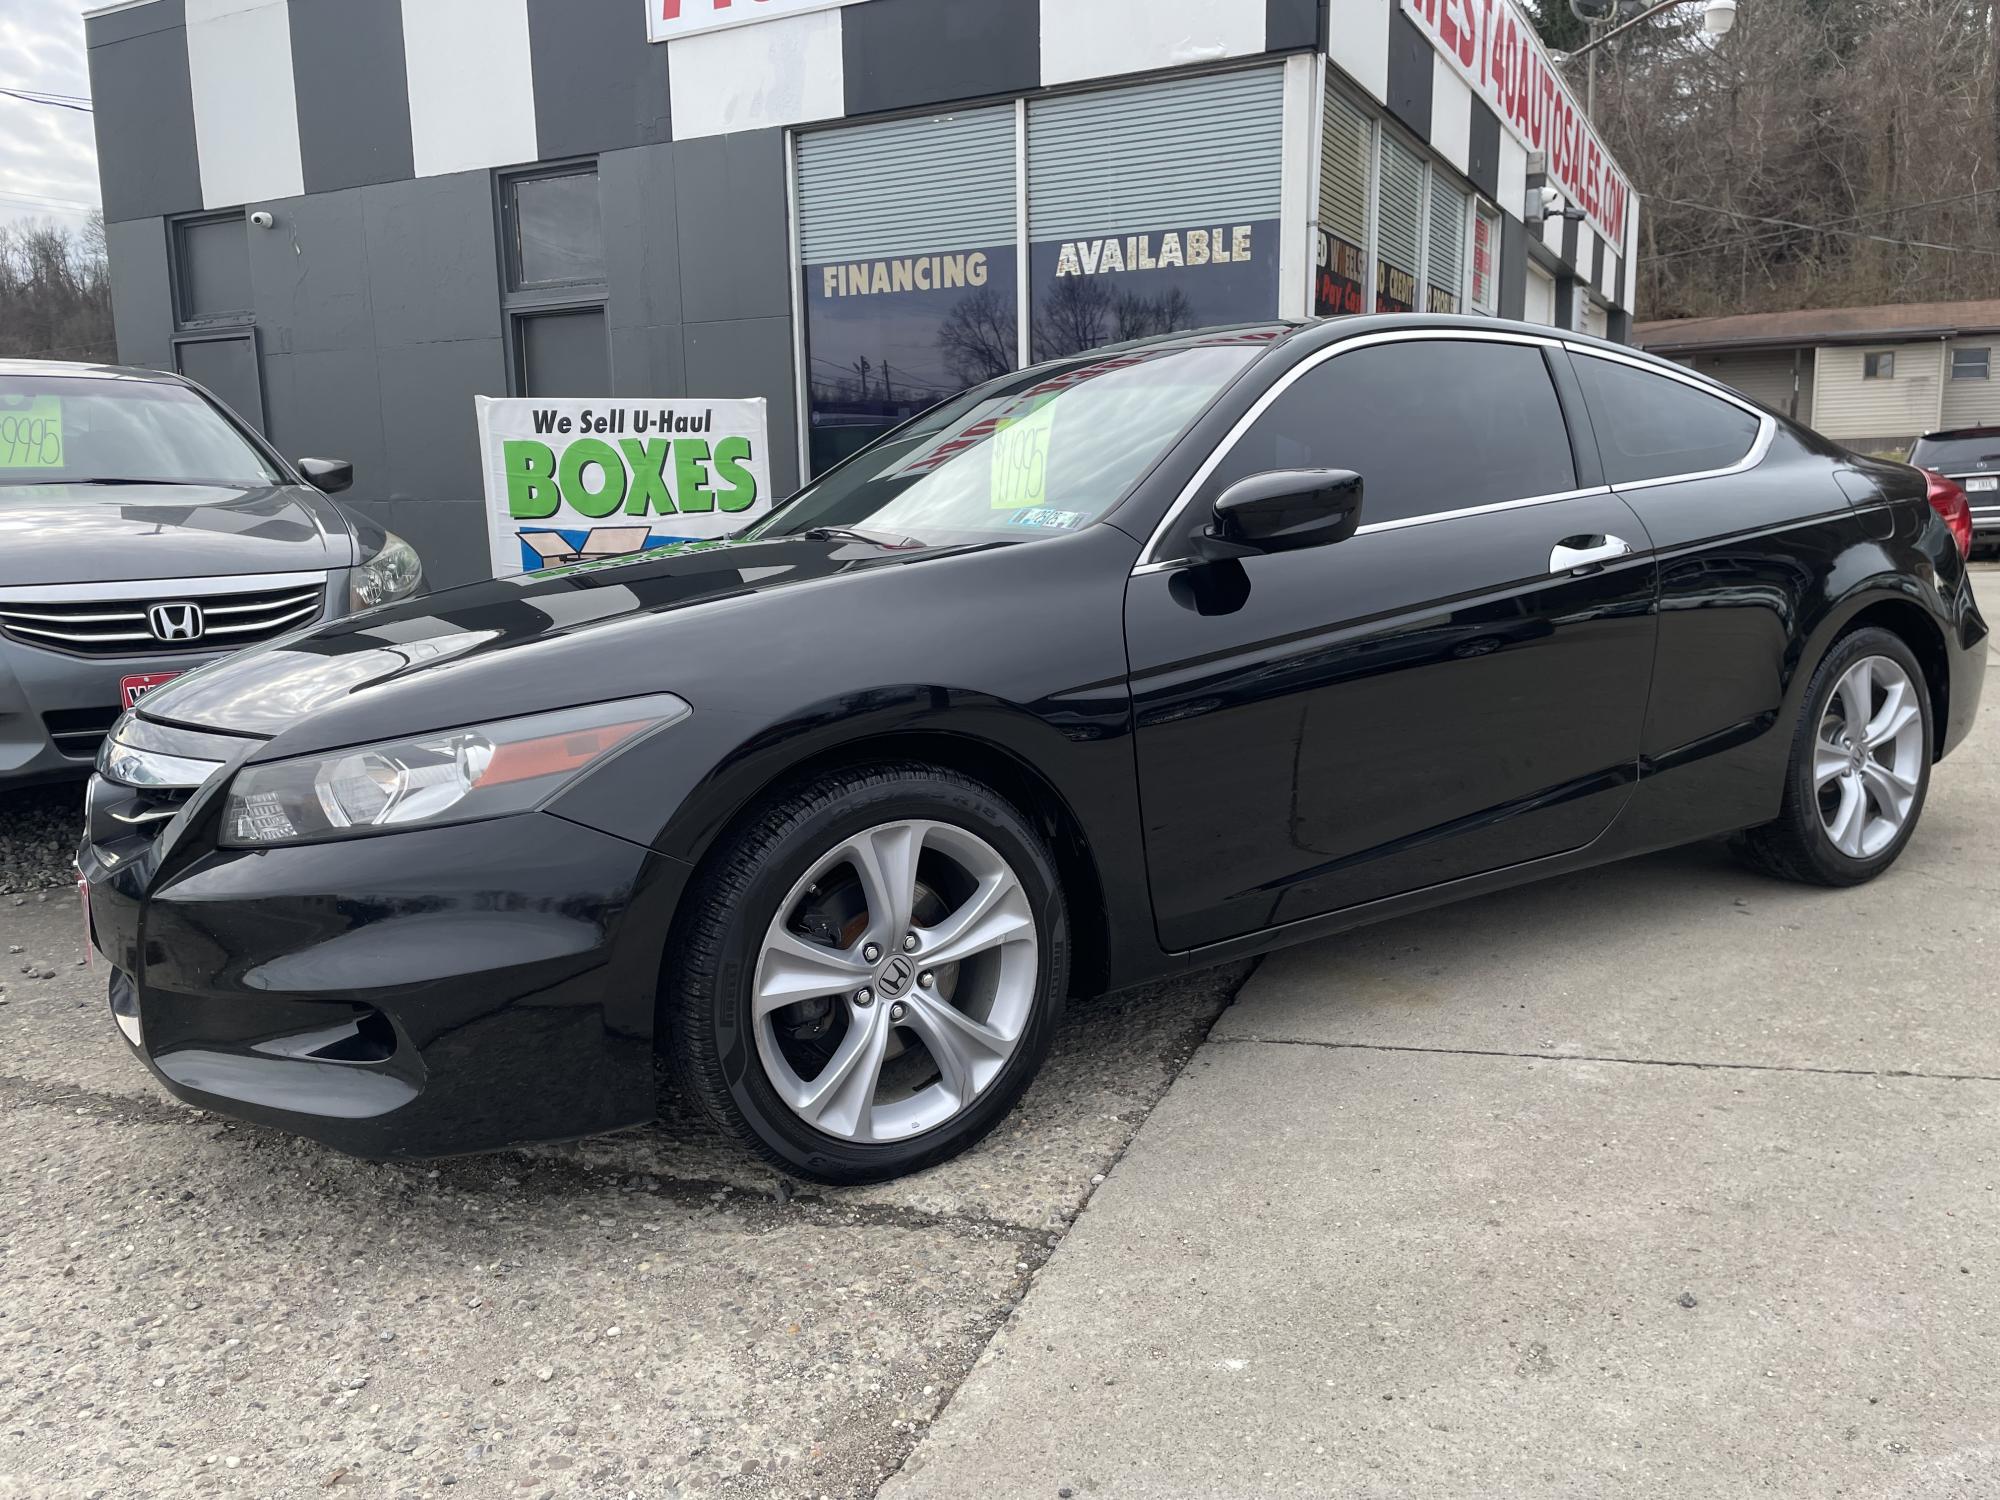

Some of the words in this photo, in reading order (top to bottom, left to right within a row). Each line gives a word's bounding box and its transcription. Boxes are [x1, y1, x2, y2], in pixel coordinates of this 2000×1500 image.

[1413, 0, 1624, 247] ST40AUTOSALES.COM
[823, 252, 988, 298] FINANCING
[1055, 225, 1252, 278] AVAILABLE
[532, 409, 571, 434] We
[580, 408, 625, 433] Sell
[633, 408, 712, 433] U-Haul
[502, 436, 757, 520] BOXES
